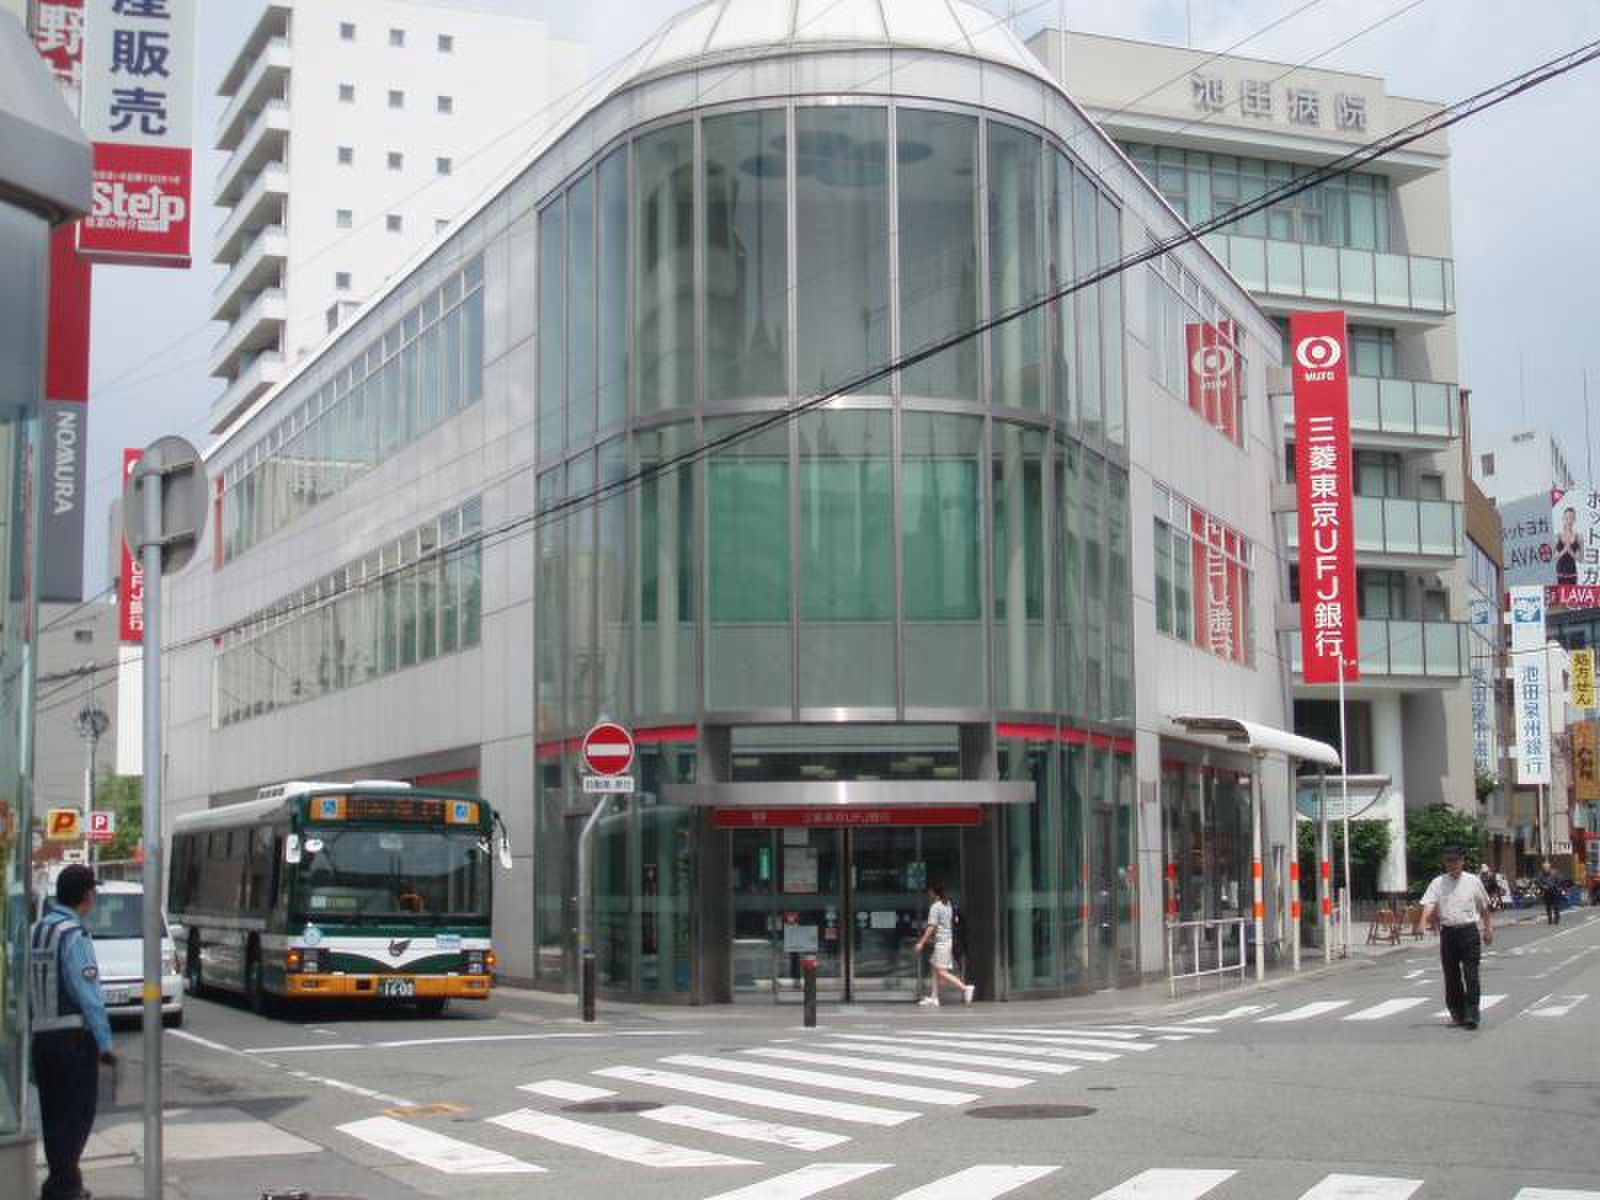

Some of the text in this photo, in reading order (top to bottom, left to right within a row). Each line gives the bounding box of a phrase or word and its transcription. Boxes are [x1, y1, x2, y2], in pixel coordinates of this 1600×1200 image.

[1192, 76, 1368, 130] 池田病院
[54, 411, 78, 515] NOMURA
[1308, 416, 1344, 658] 三菱東京UFJ銀行
[1560, 587, 1595, 604] LAVA
[95, 815, 106, 831] P
